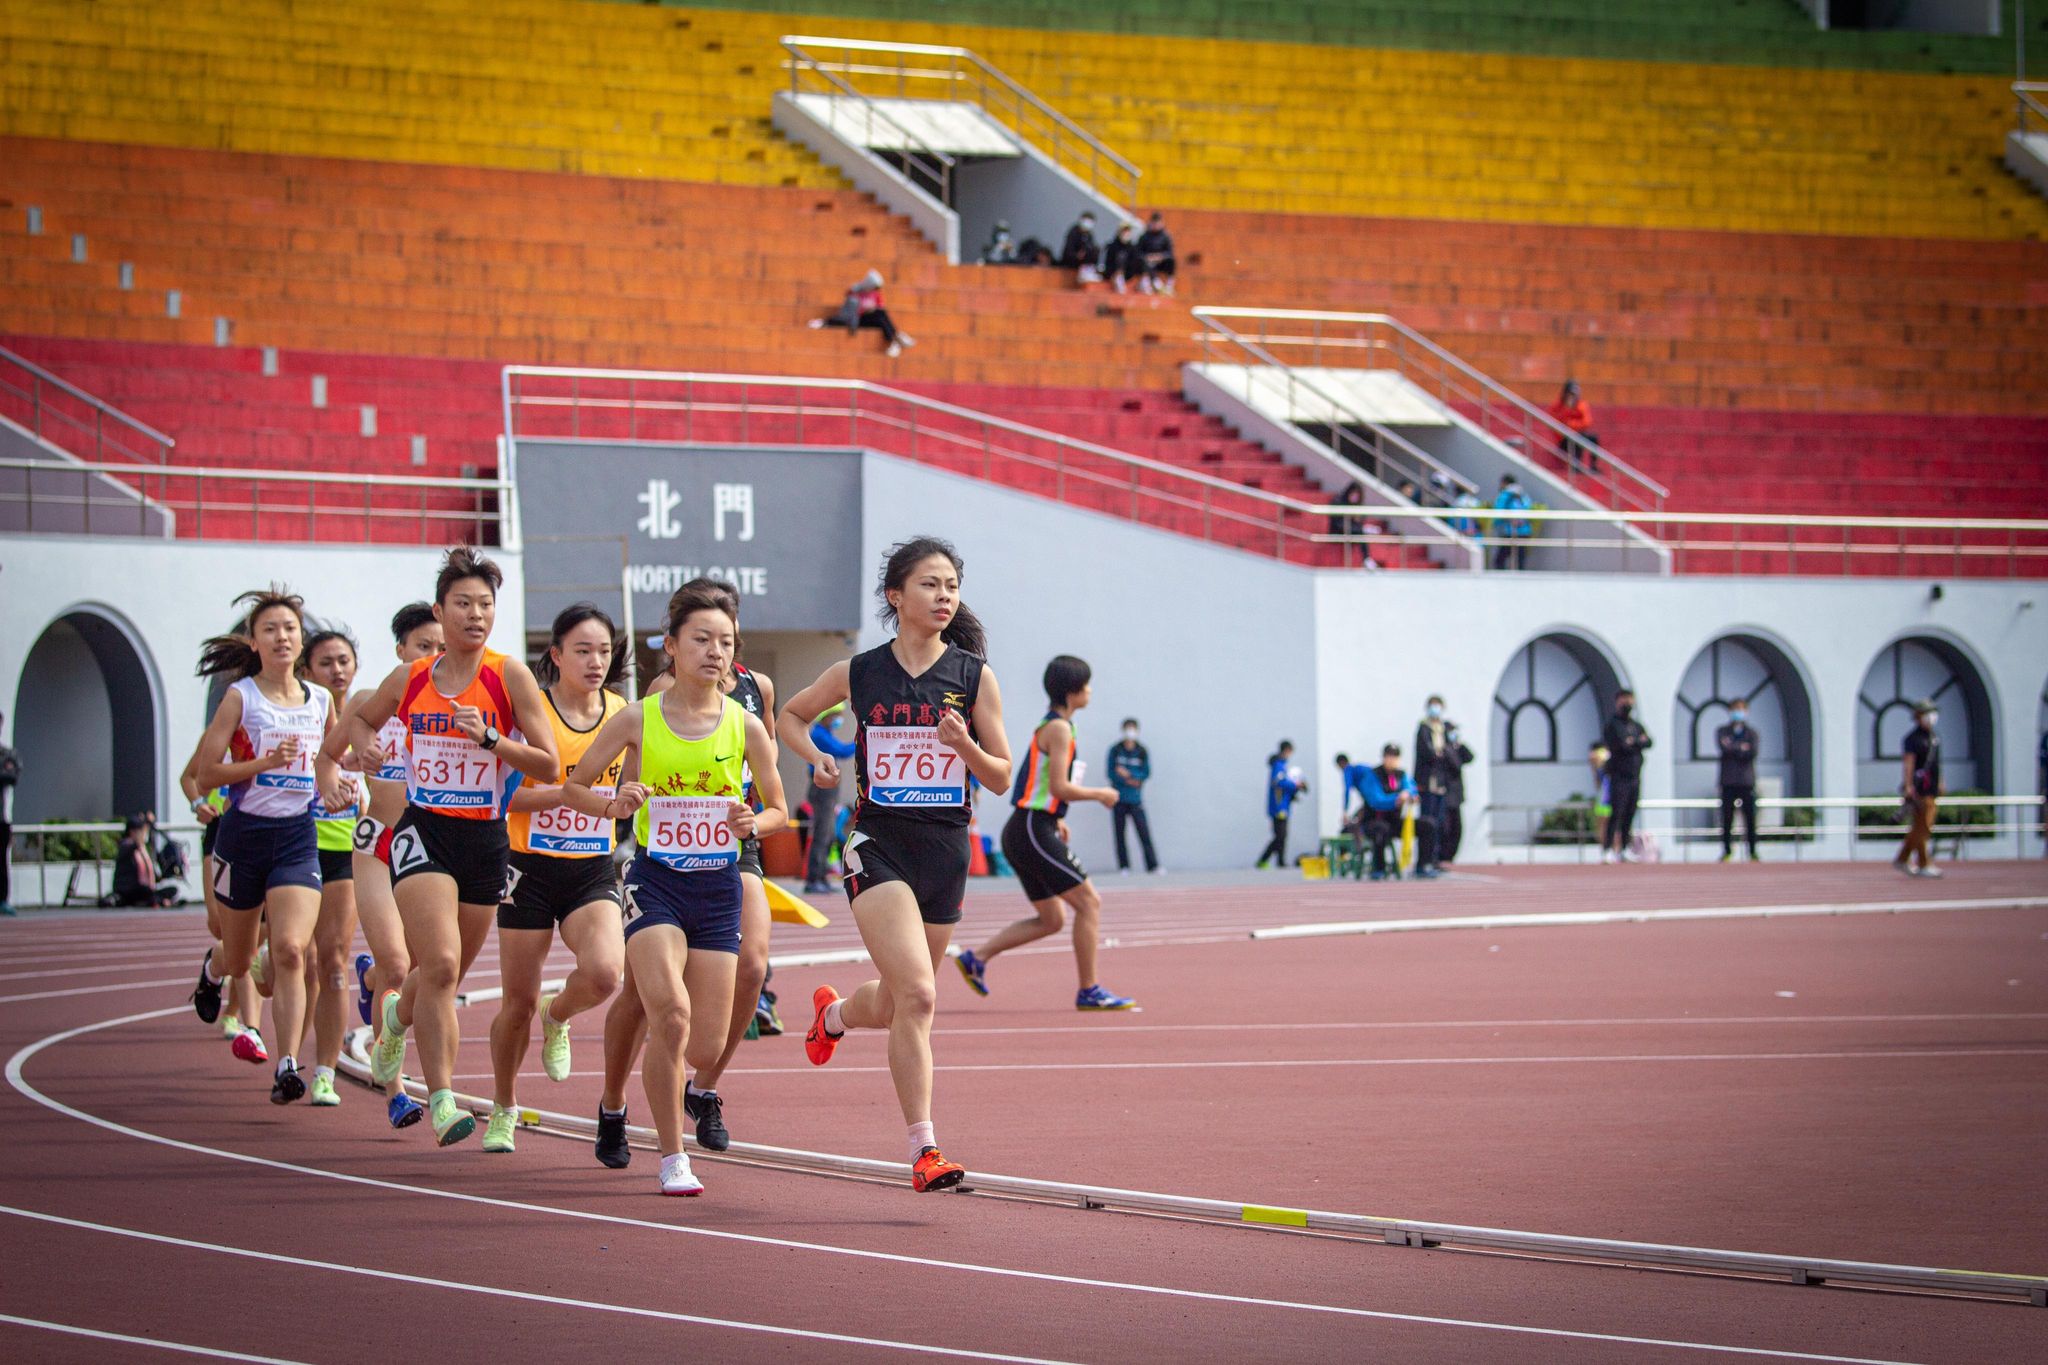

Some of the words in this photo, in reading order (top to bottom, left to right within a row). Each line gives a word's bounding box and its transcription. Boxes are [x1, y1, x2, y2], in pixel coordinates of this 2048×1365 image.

[637, 479, 755, 541] 北門
[626, 565, 701, 593] NORTH
[417, 759, 489, 786] 5317
[874, 752, 957, 781] 5767
[353, 818, 376, 849] 9
[656, 821, 730, 847] 5606
[394, 831, 423, 870] 2
[212, 857, 228, 887] 7
